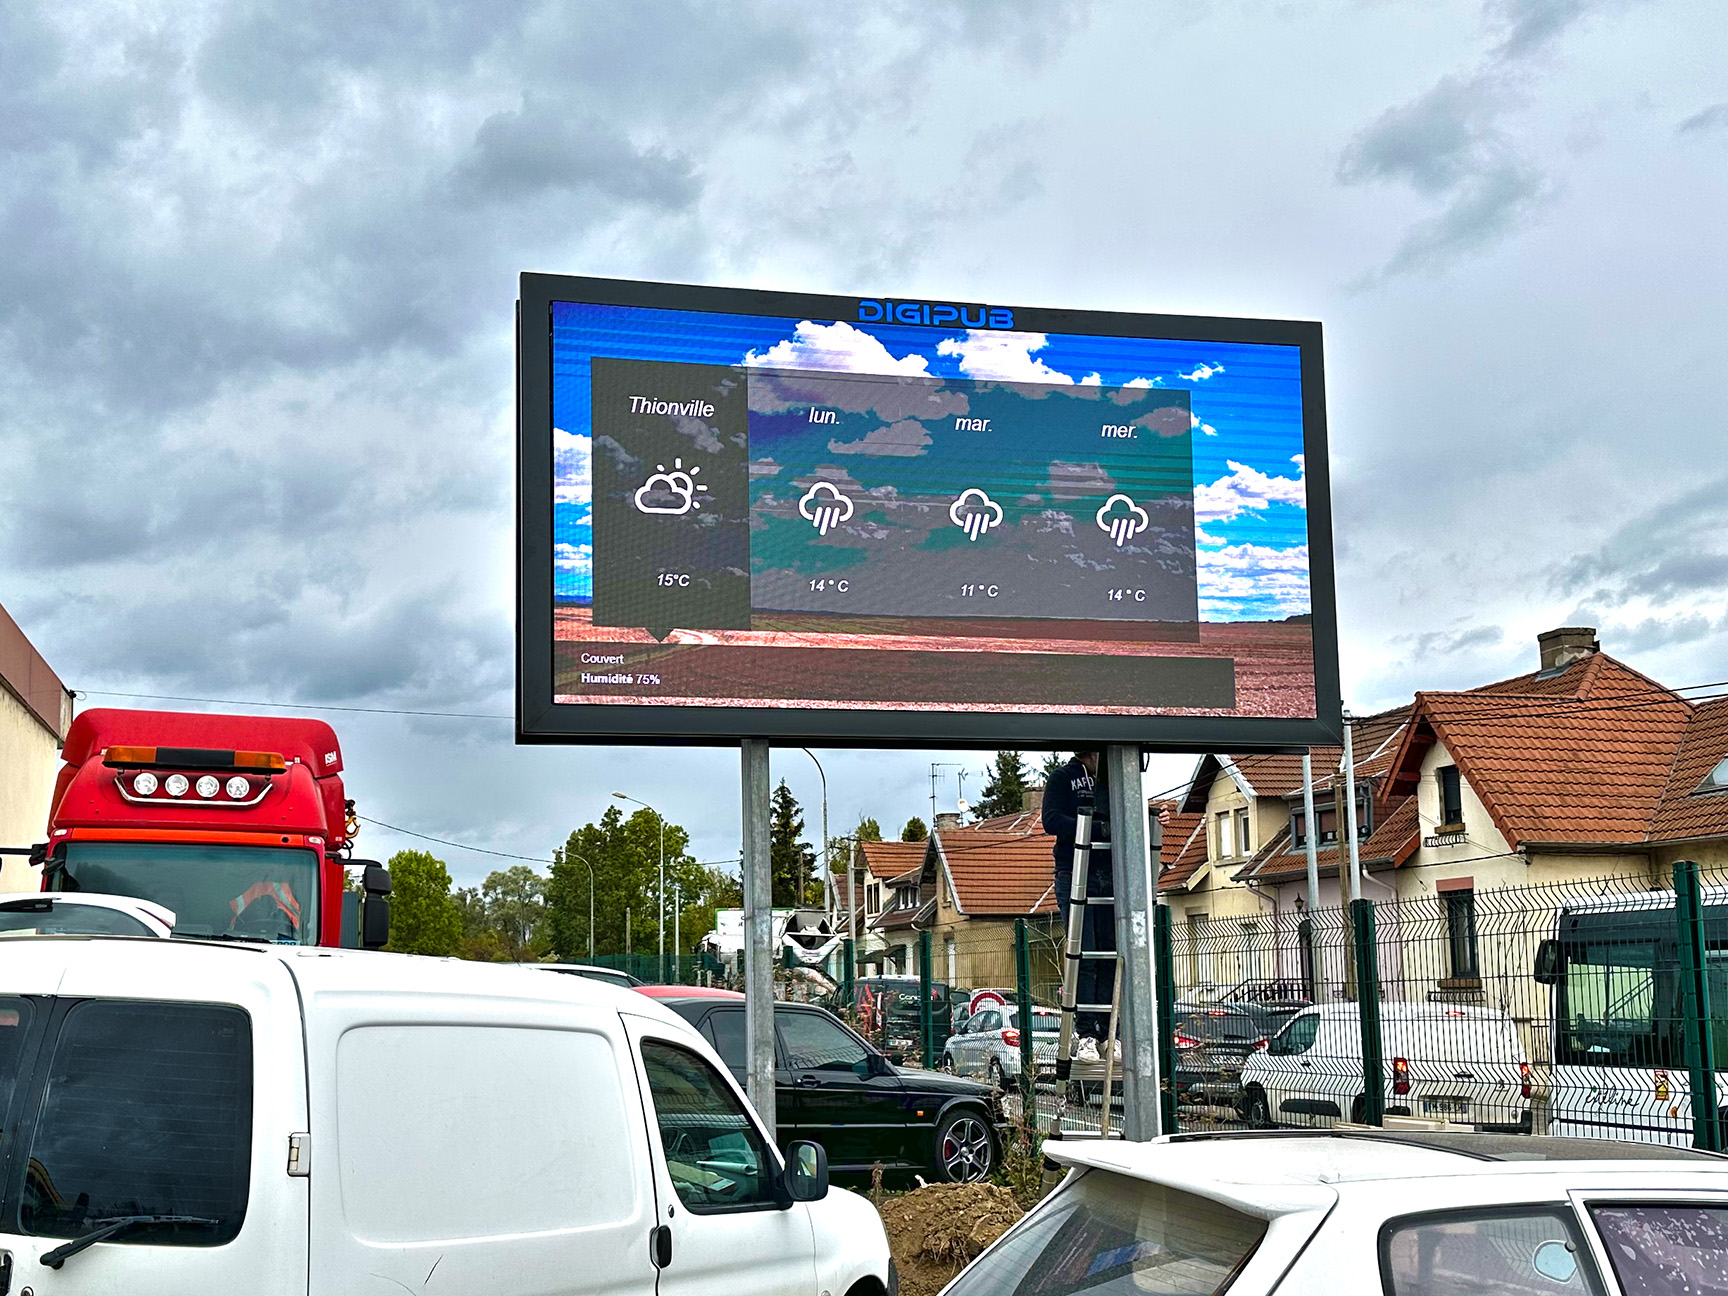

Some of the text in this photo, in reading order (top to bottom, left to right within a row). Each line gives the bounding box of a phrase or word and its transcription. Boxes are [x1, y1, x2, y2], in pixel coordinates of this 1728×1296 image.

[858, 300, 1014, 330] DIGIPUB
[628, 395, 715, 418] Thionville
[808, 406, 840, 425] lun.
[954, 417, 993, 432] mar.
[1101, 424, 1138, 439] mer.
[657, 573, 690, 587] 15°C
[580, 652, 624, 665] Couvert
[580, 672, 661, 685] Humidité 75%
